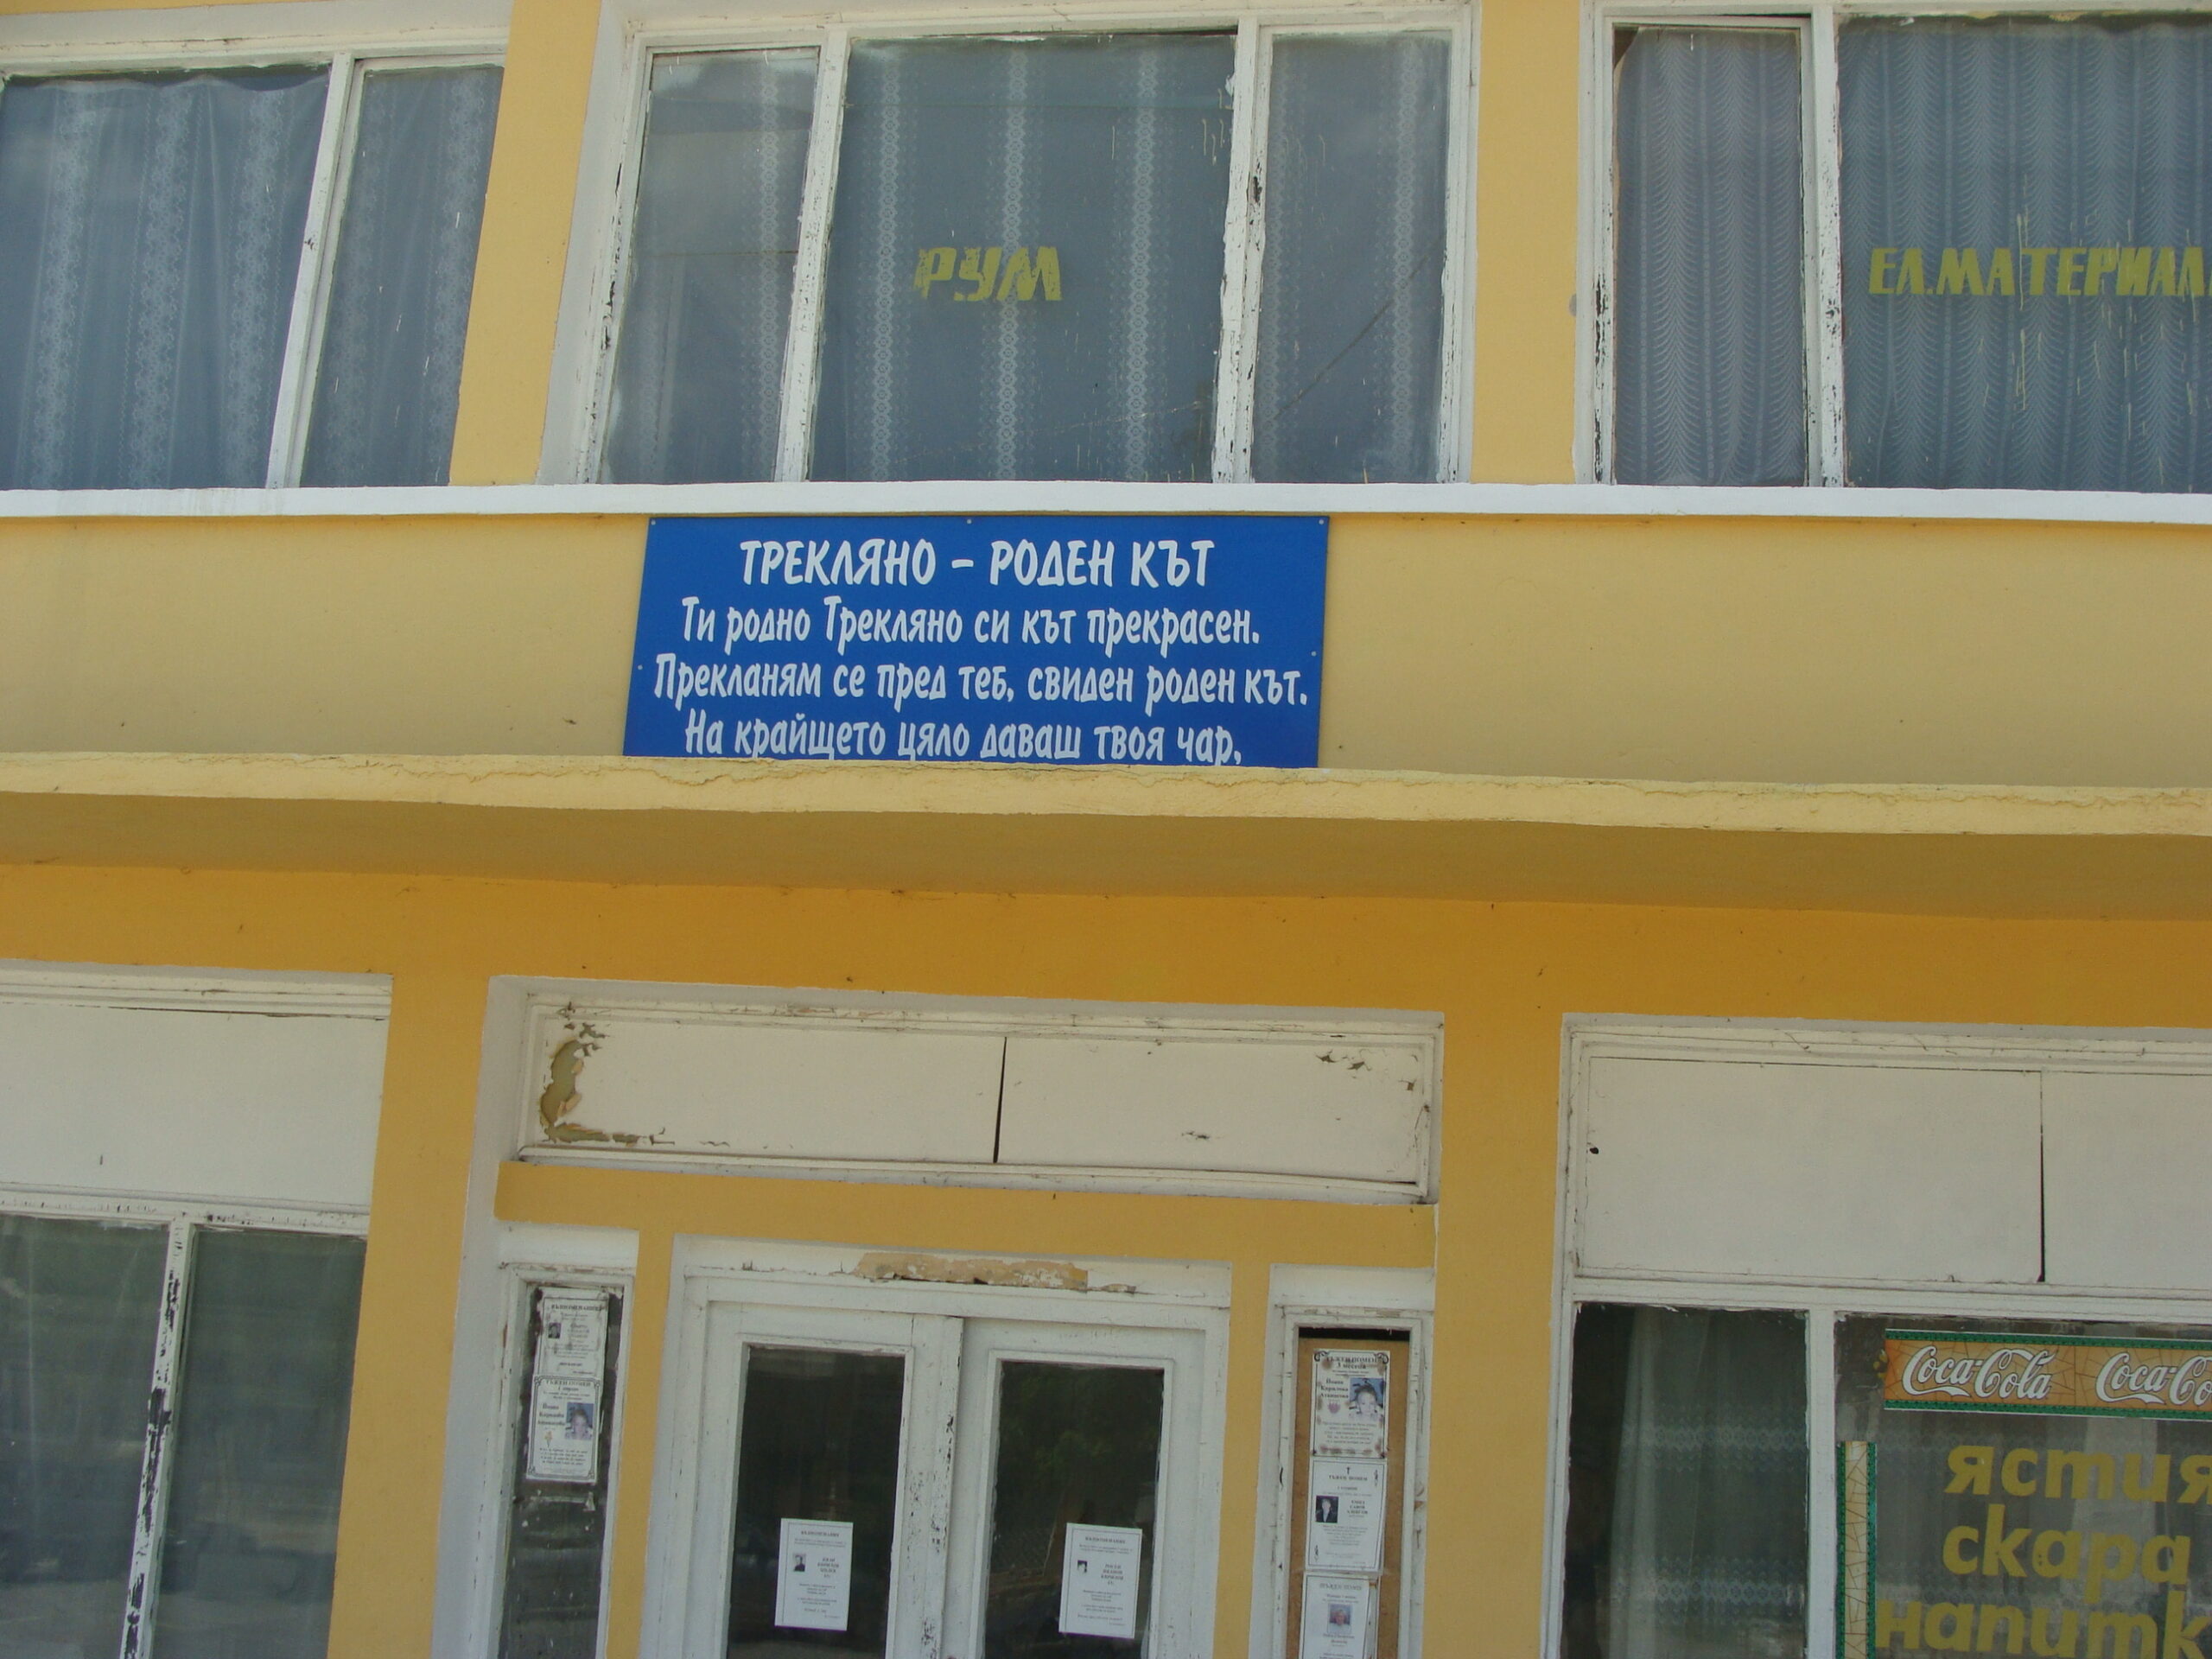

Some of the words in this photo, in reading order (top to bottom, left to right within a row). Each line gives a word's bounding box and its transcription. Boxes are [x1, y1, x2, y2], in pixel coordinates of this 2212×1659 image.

[912, 246, 1062, 301] РУМ
[1868, 246, 2212, 296] ЕЛ.МАТЕРИАЛ
[740, 538, 937, 586] ТРЕКЛЯНО
[989, 538, 1115, 587] РОДЕН
[1130, 539, 1215, 588] КЪТ
[681, 595, 716, 642] Ти
[724, 607, 811, 656] родно
[823, 594, 963, 656] Трекляно
[974, 608, 1010, 644] си
[1021, 608, 1077, 644] кът
[1087, 607, 1260, 658] прекрасен.
[653, 652, 822, 711] Прекланям
[832, 664, 866, 698] се
[876, 663, 947, 713] пред
[957, 664, 1014, 702] теб,
[1027, 665, 1135, 702] свиден
[1144, 664, 1236, 717] роден
[1244, 669, 1308, 706] кът.
[684, 708, 724, 755] На
[734, 711, 887, 760] крайщето
[897, 721, 970, 760] цяло
[979, 722, 1082, 760] даваш
[1093, 724, 1166, 761] твоя
[1177, 724, 1242, 766] чар,
[1902, 1345, 2056, 1400] Coca-Cola
